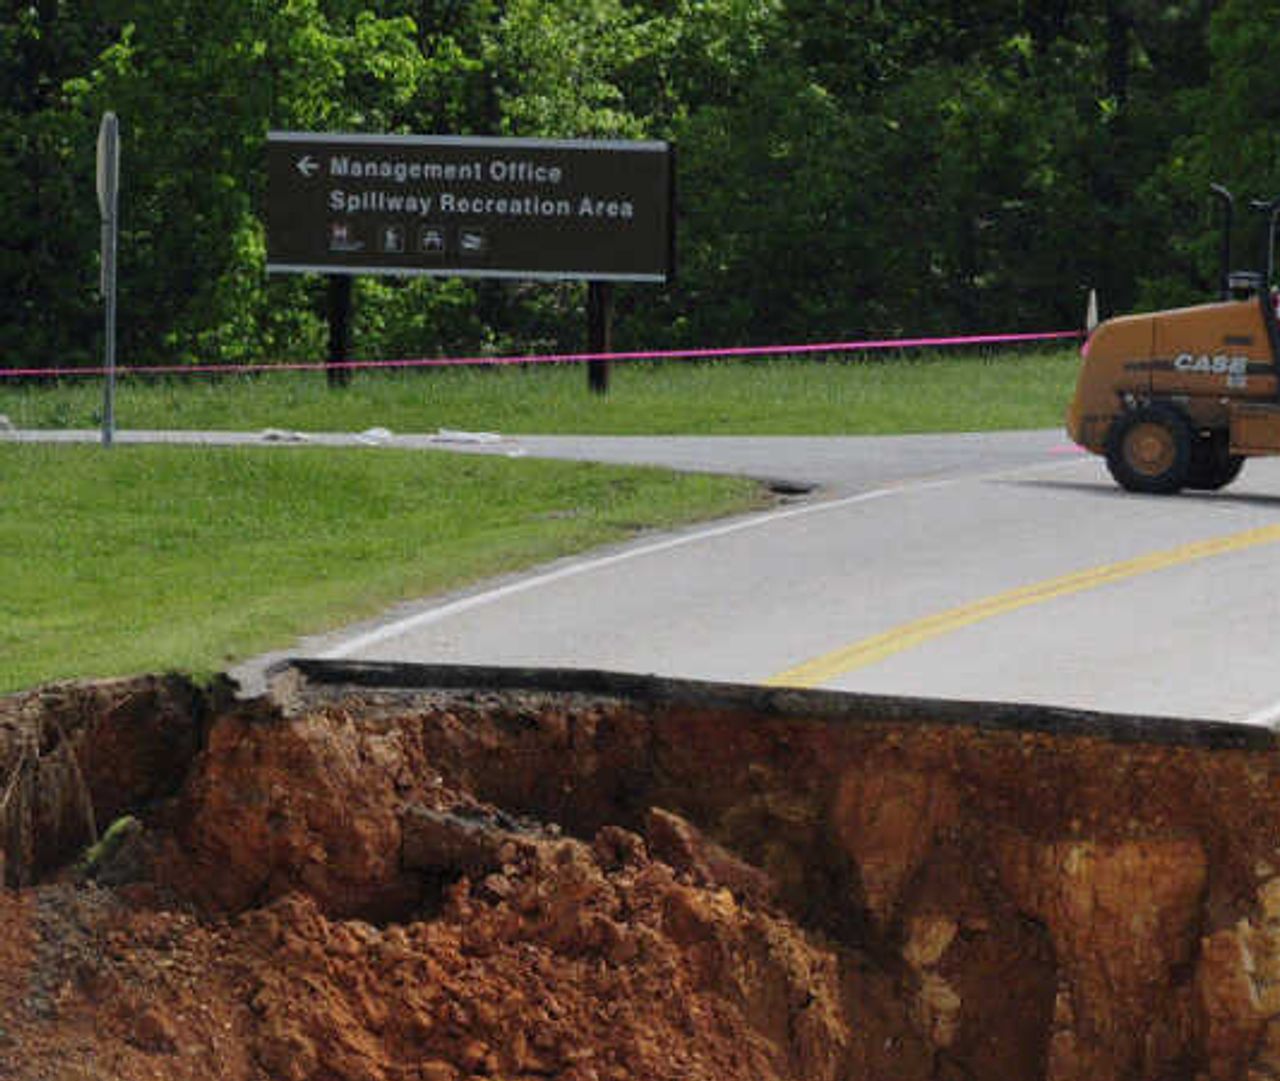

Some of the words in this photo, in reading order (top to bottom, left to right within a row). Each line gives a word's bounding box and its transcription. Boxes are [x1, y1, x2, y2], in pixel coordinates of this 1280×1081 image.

[330, 157, 481, 182] Management
[490, 161, 562, 182] Office
[329, 190, 431, 214] Spillway
[440, 194, 571, 216] Recreation
[578, 198, 634, 218] Area
[1174, 352, 1248, 373] CASE
